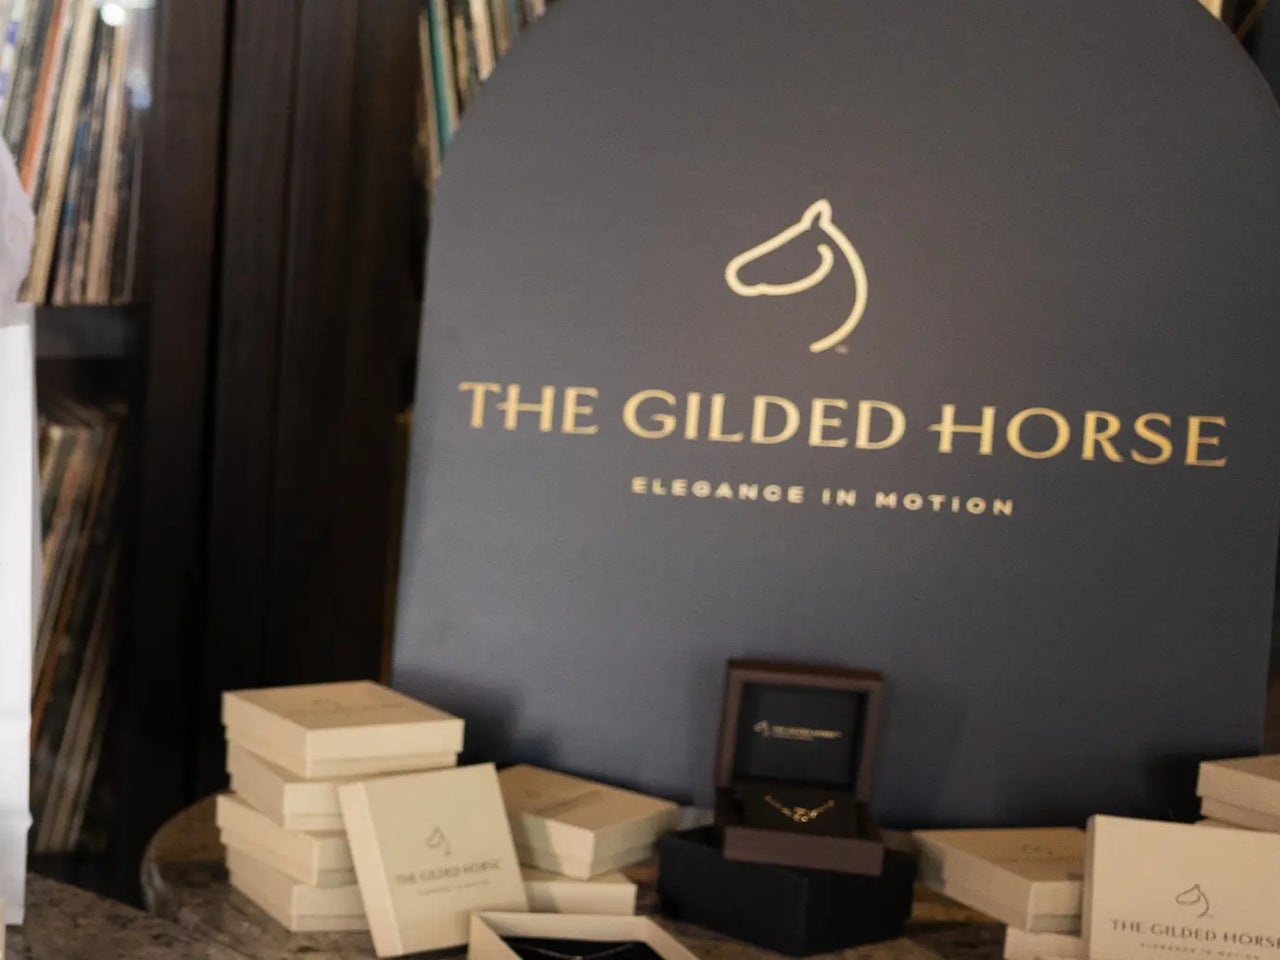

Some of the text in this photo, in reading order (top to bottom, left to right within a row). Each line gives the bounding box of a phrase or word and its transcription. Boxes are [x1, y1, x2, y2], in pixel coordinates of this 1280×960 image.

[457, 381, 1228, 467] THE GILDED HORSE
[631, 476, 1014, 516] ELEGANCE IN MOTION
